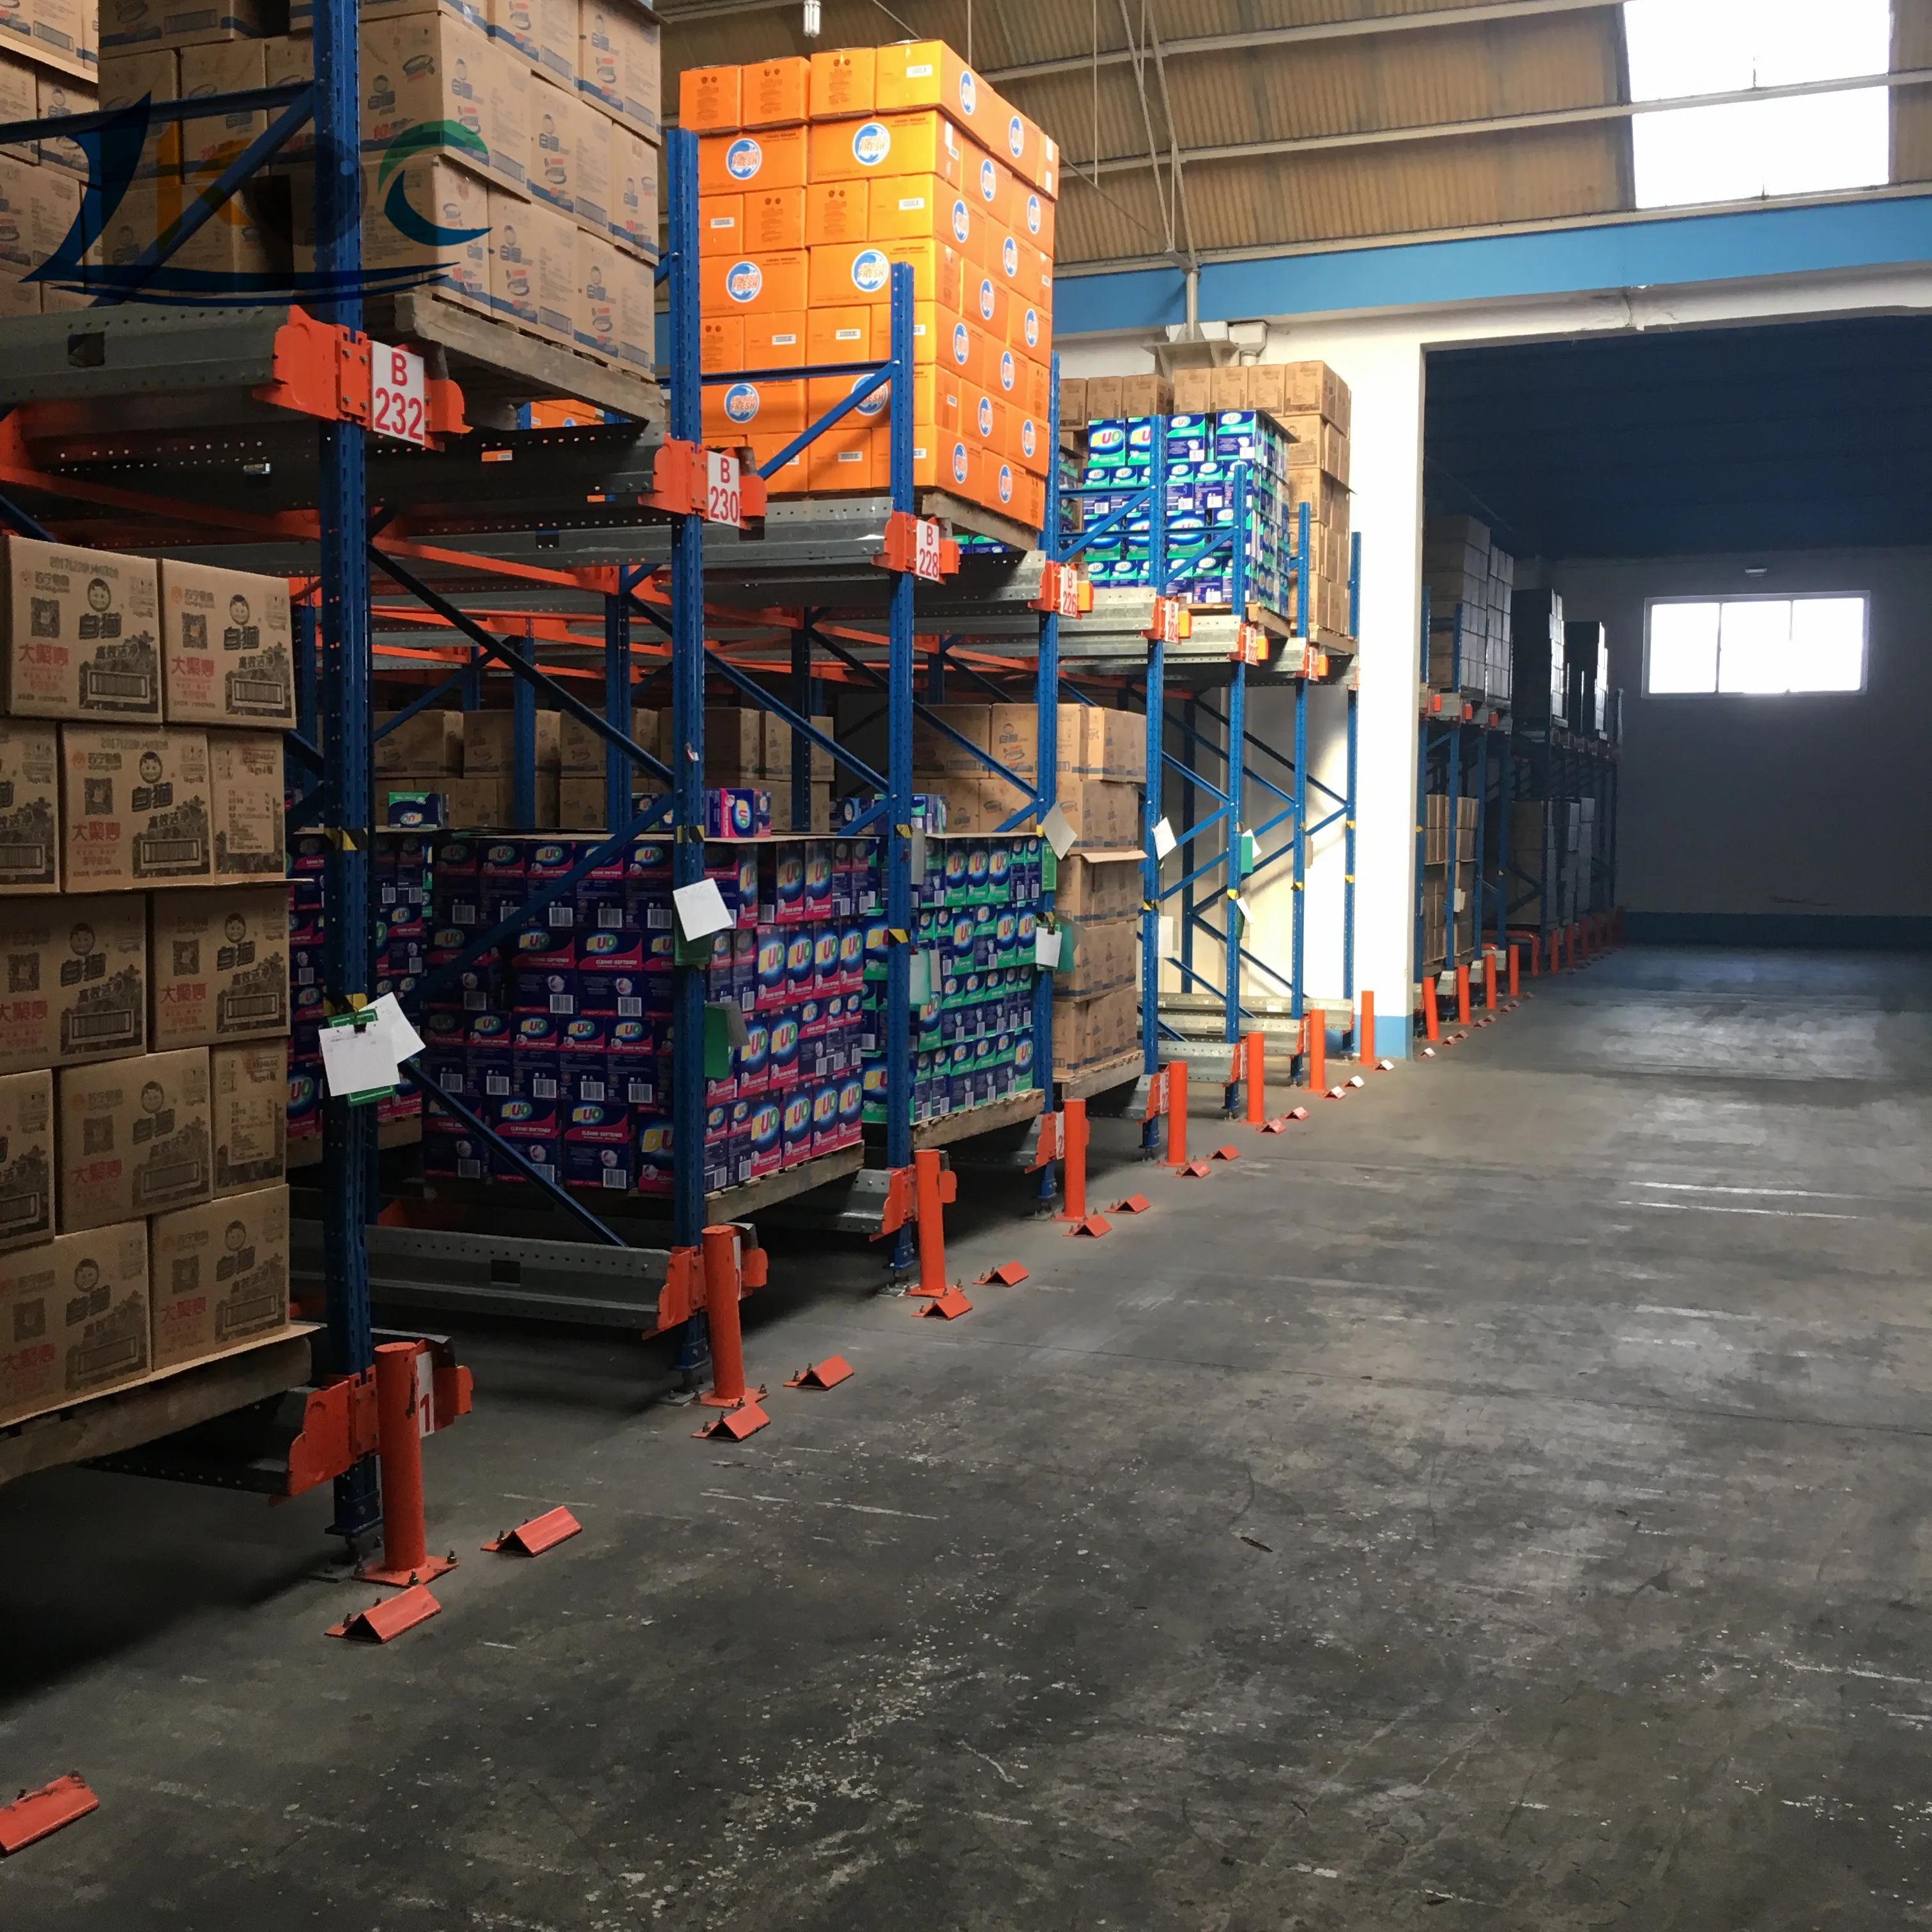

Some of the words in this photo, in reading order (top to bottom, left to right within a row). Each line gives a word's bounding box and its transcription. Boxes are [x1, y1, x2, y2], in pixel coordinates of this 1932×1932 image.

[859, 142, 884, 151] FRESH
[732, 157, 757, 167] FRESH
[733, 280, 758, 289] FRESH
[858, 269, 884, 279] FRESH
[390, 352, 407, 387] B
[374, 387, 424, 441] 232
[730, 401, 756, 411] FRESH
[1091, 431, 1122, 447] DUO
[1130, 430, 1151, 444] DU
[720, 457, 731, 484] B
[710, 487, 739, 523] 230
[926, 525, 933, 546] B
[919, 548, 940, 579] 228
[1068, 571, 1073, 588] B
[1062, 590, 1077, 615] 226
[1170, 605, 1176, 619] B
[1167, 620, 1178, 641] 224
[586, 935, 618, 951] DUO
[651, 937, 674, 952] DU
[841, 933, 862, 960] DUO
[866, 929, 889, 949] DU
[758, 944, 785, 974] DUO
[788, 940, 812, 969] DUO
[816, 937, 838, 964] DUO
[569, 1023, 595, 1035] DUO
[616, 1023, 642, 1036] DUO
[771, 1023, 797, 1054] DUO
[291, 1079, 314, 1101] UO
[864, 1071, 887, 1090] DU
[814, 1091, 838, 1121] DUO
[839, 1083, 861, 1113] DUO
[502, 1103, 530, 1118] DUO
[572, 1107, 604, 1123] DUO
[785, 1099, 810, 1131] DUO
[751, 1108, 779, 1140] DUO
[642, 1128, 674, 1153] DU
